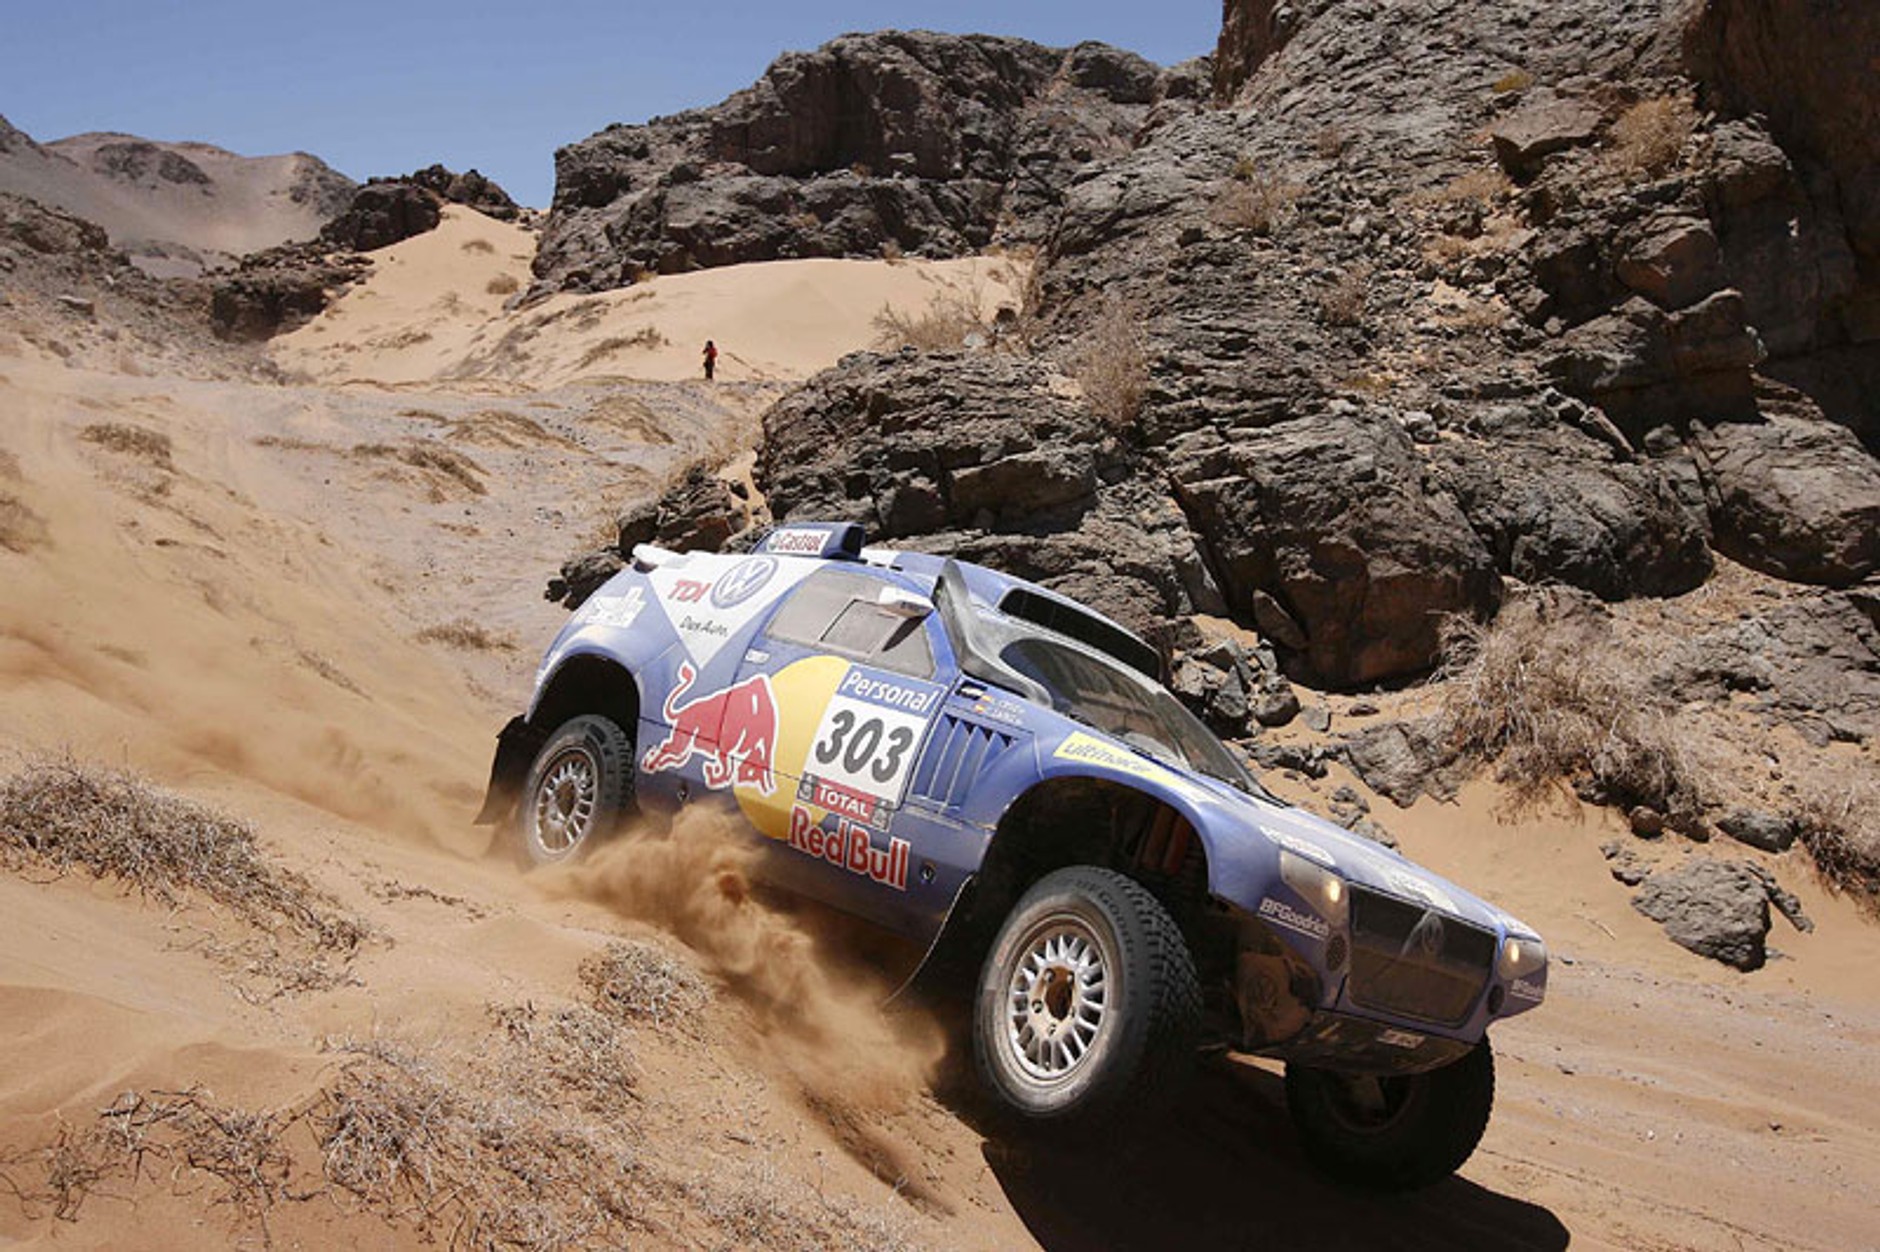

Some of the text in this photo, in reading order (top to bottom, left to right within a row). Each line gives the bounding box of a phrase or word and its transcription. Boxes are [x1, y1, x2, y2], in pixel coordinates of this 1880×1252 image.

[778, 532, 826, 551] Castrol
[667, 580, 712, 603] TDI
[680, 615, 701, 631] Das
[841, 671, 939, 712] Personal
[815, 709, 914, 783] 303
[819, 784, 869, 816] TOTAL
[789, 804, 911, 889] Red Bull
[1259, 897, 1329, 936] BFGoodrich
